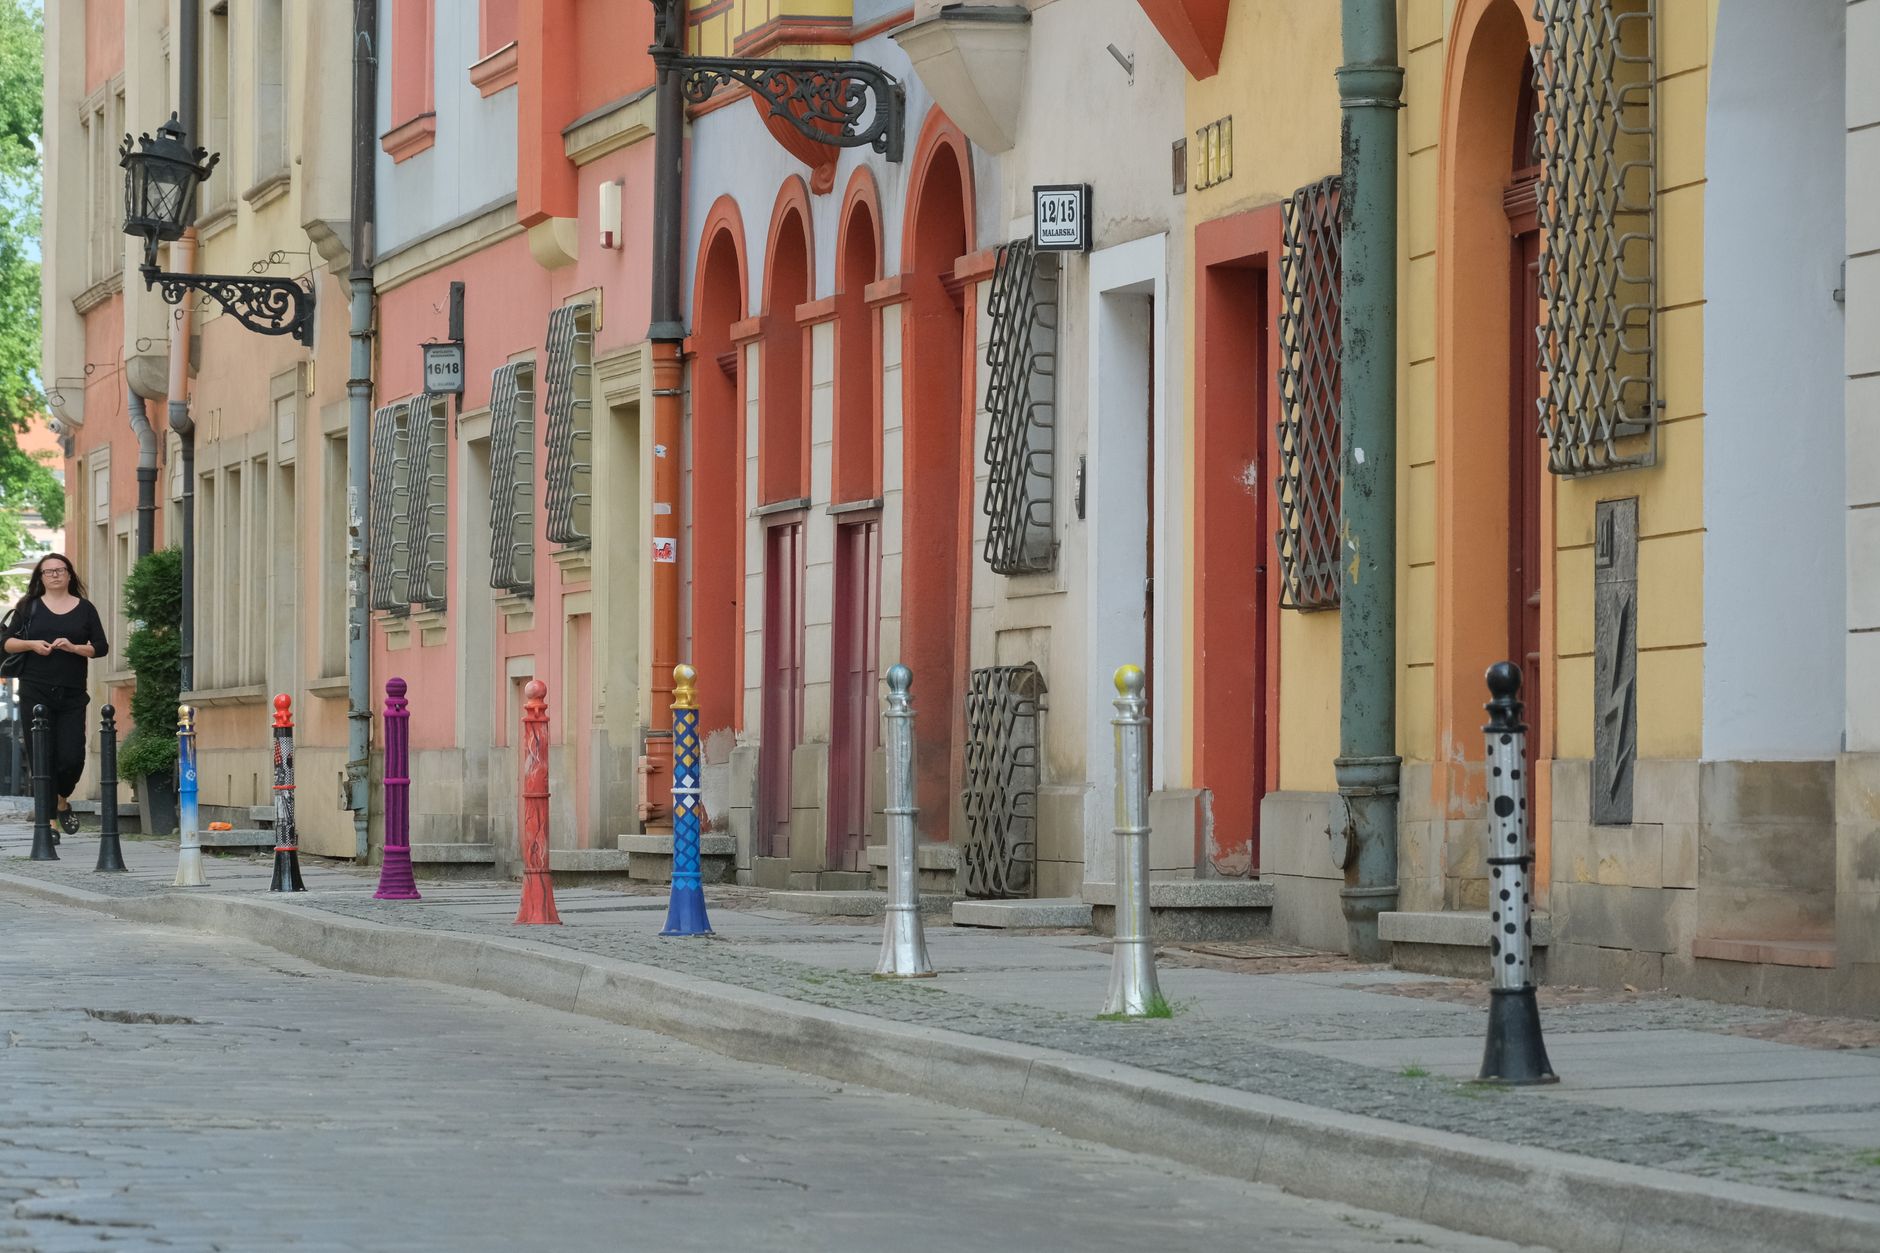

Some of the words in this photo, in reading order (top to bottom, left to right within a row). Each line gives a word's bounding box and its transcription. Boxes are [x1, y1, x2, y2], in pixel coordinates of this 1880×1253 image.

[1042, 198, 1075, 225] 12/15
[1042, 228, 1075, 237] MALARSKA
[427, 362, 459, 375] 16/18
